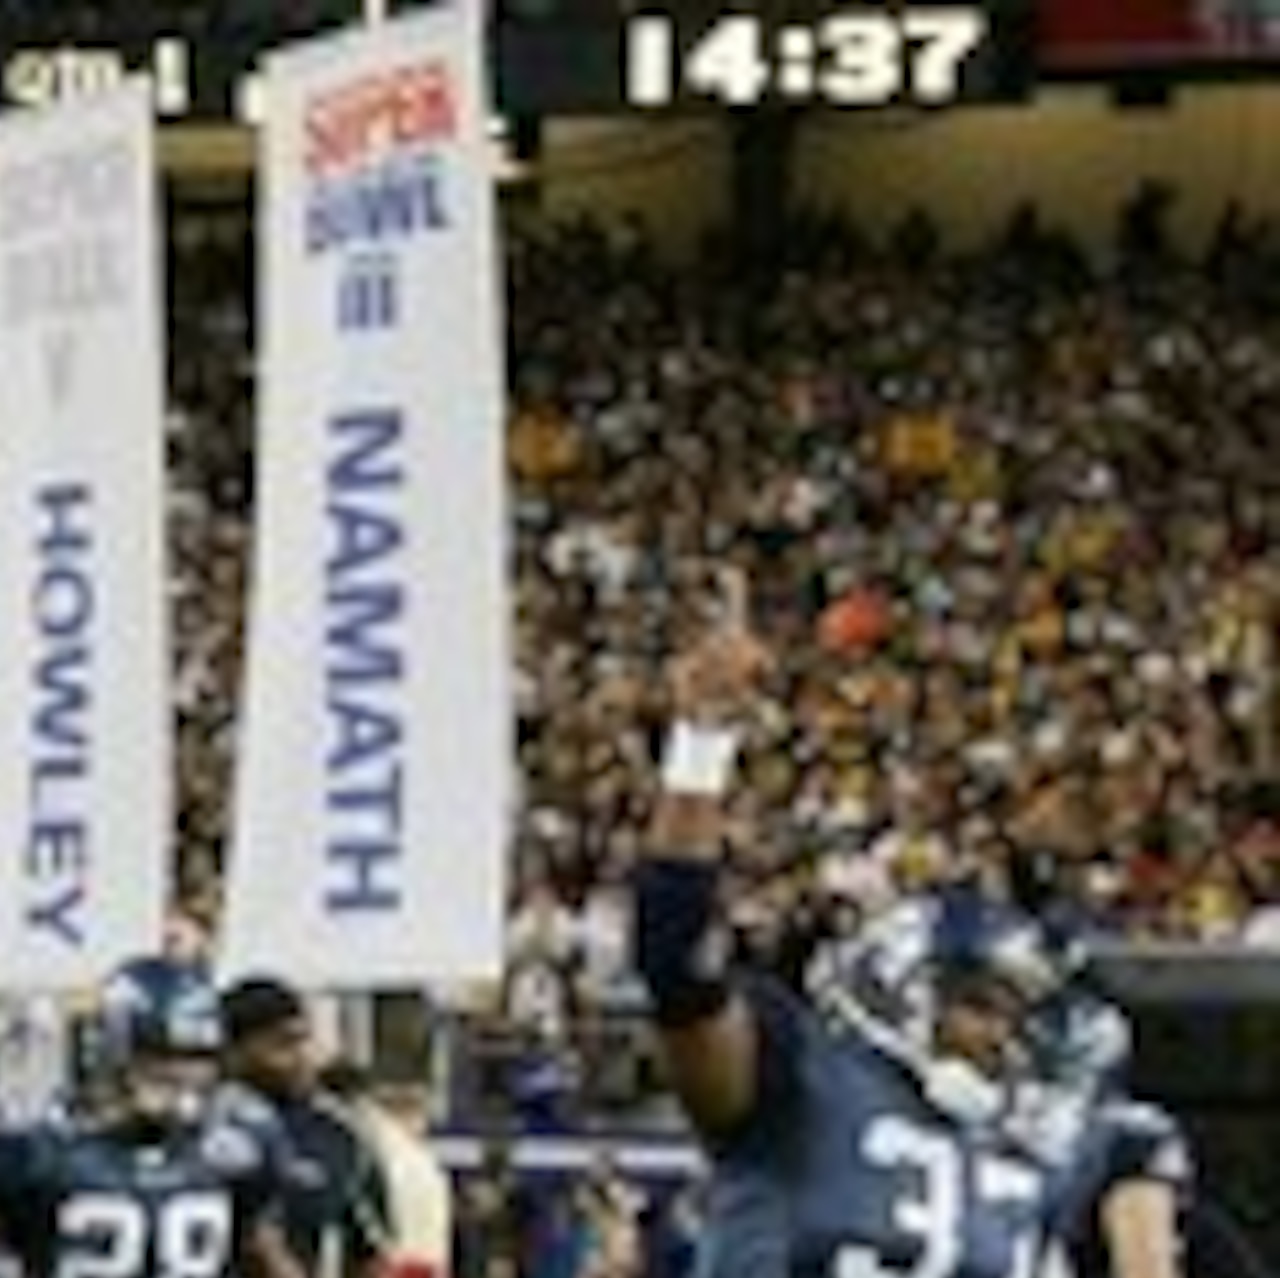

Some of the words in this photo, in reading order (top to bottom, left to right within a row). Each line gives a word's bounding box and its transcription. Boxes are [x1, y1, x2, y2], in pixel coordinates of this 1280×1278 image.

[302, 60, 458, 172] SUPER
[624, 14, 984, 108] 14:37
[26, 482, 95, 946] HOWLEY
[324, 408, 404, 914] NAMATH
